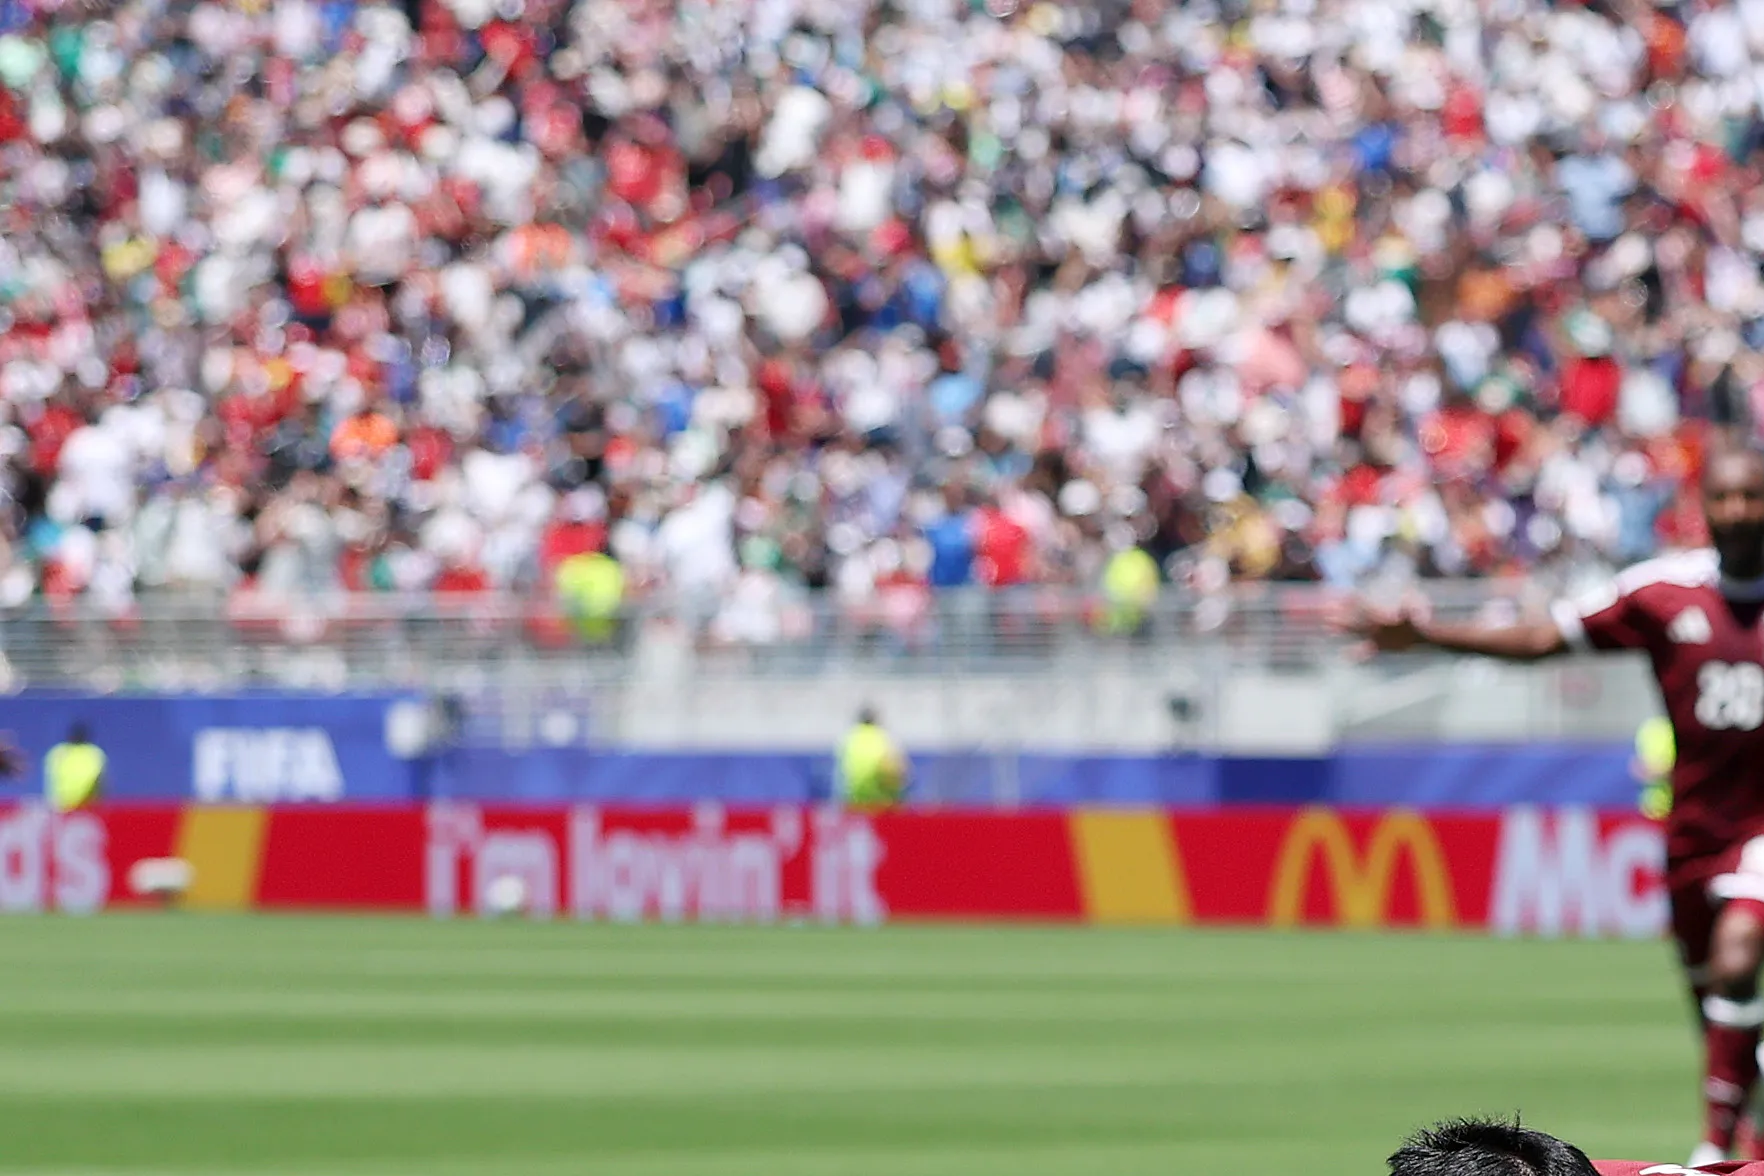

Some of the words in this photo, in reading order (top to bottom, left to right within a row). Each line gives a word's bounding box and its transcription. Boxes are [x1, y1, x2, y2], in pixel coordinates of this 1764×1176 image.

[193, 727, 347, 803] FIFA
[424, 798, 560, 922] i'm
[812, 797, 887, 928] it
